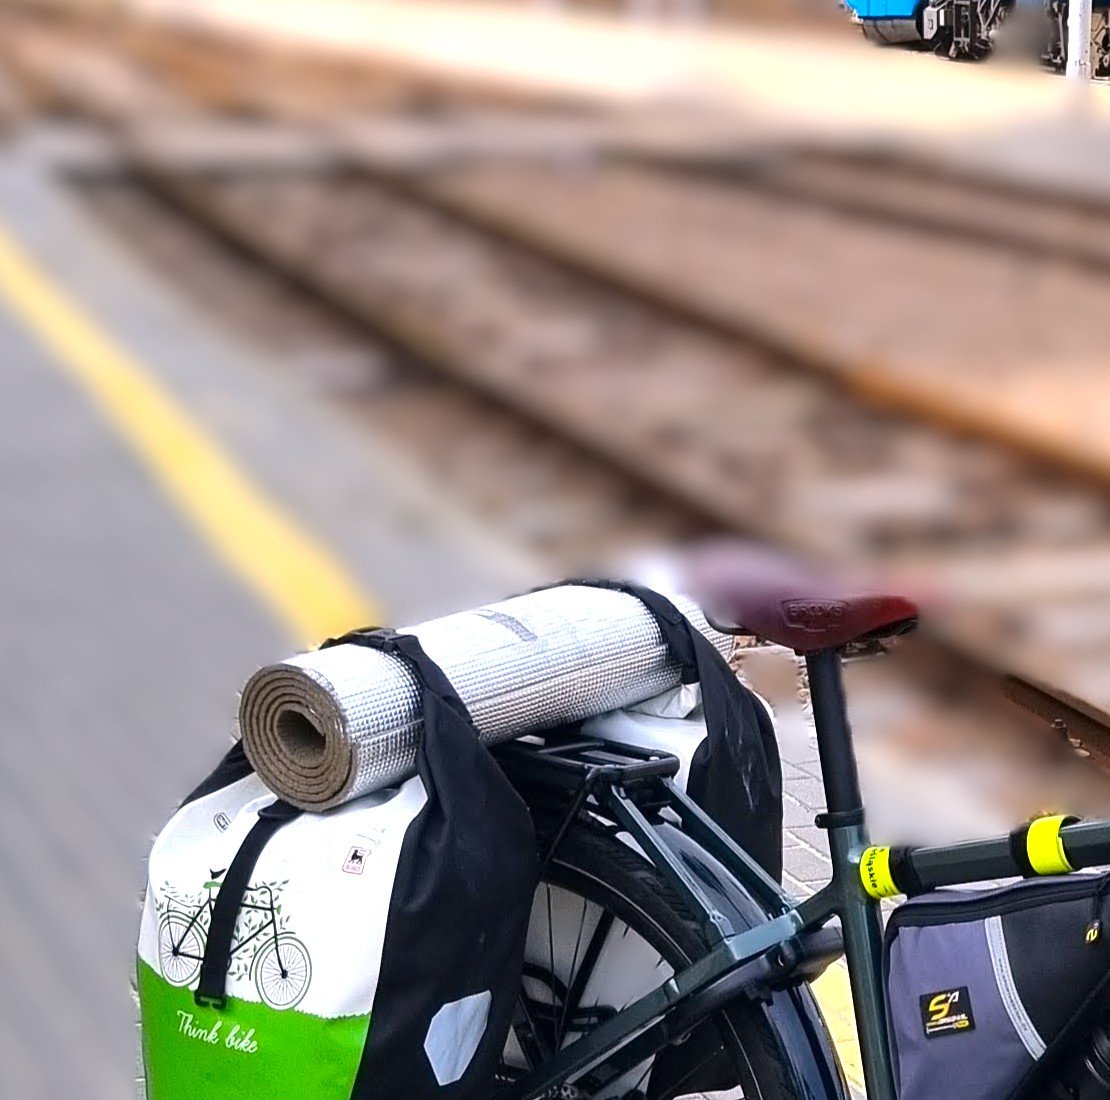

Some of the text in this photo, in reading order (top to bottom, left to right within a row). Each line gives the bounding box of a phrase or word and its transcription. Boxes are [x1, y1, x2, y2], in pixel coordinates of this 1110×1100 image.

[787, 603, 843, 617] BROOKS
[176, 1010, 259, 1054] Think bike
